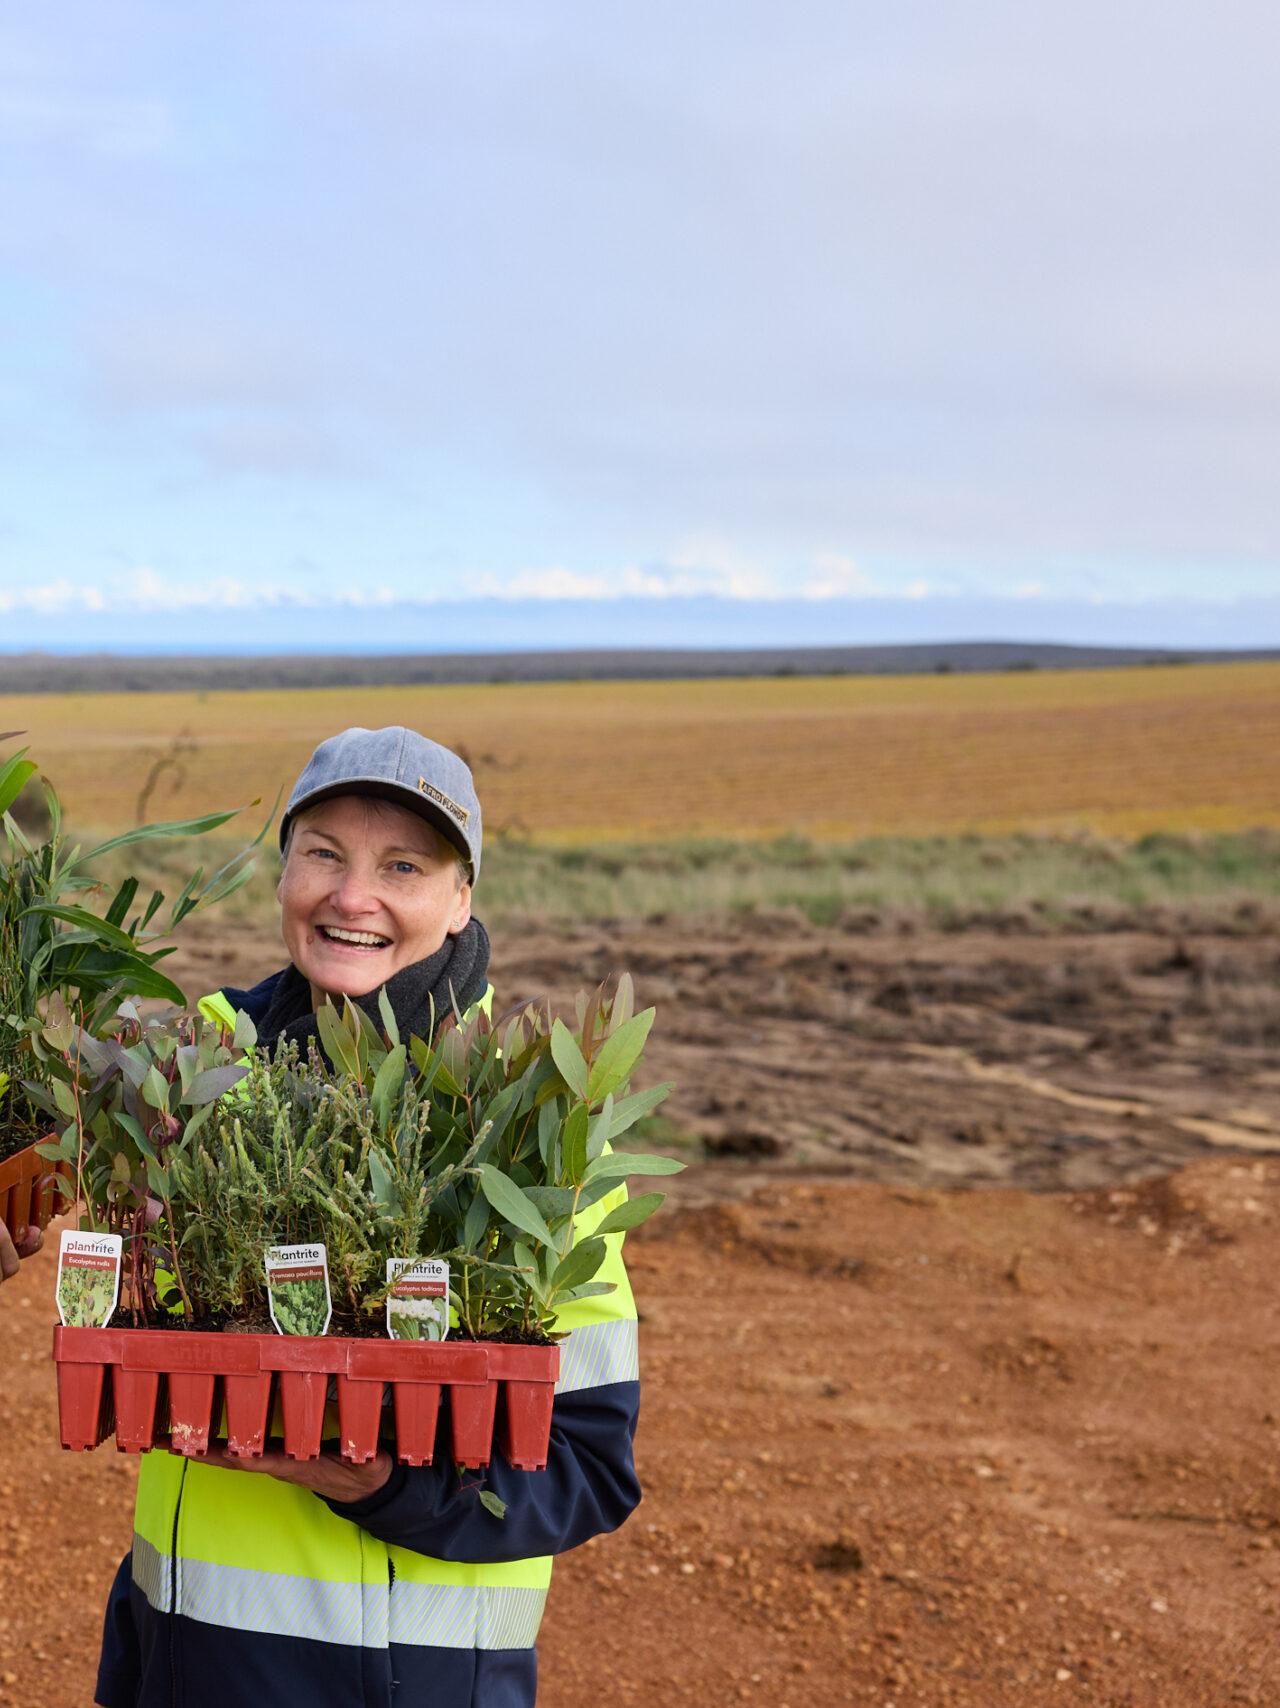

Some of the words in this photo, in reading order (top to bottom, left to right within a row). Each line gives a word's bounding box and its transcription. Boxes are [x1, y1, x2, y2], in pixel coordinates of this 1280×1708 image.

[66, 1241, 115, 1254] plantrite
[68, 1256, 97, 1267] Eucalyptus
[394, 1263, 443, 1275] Plntrite
